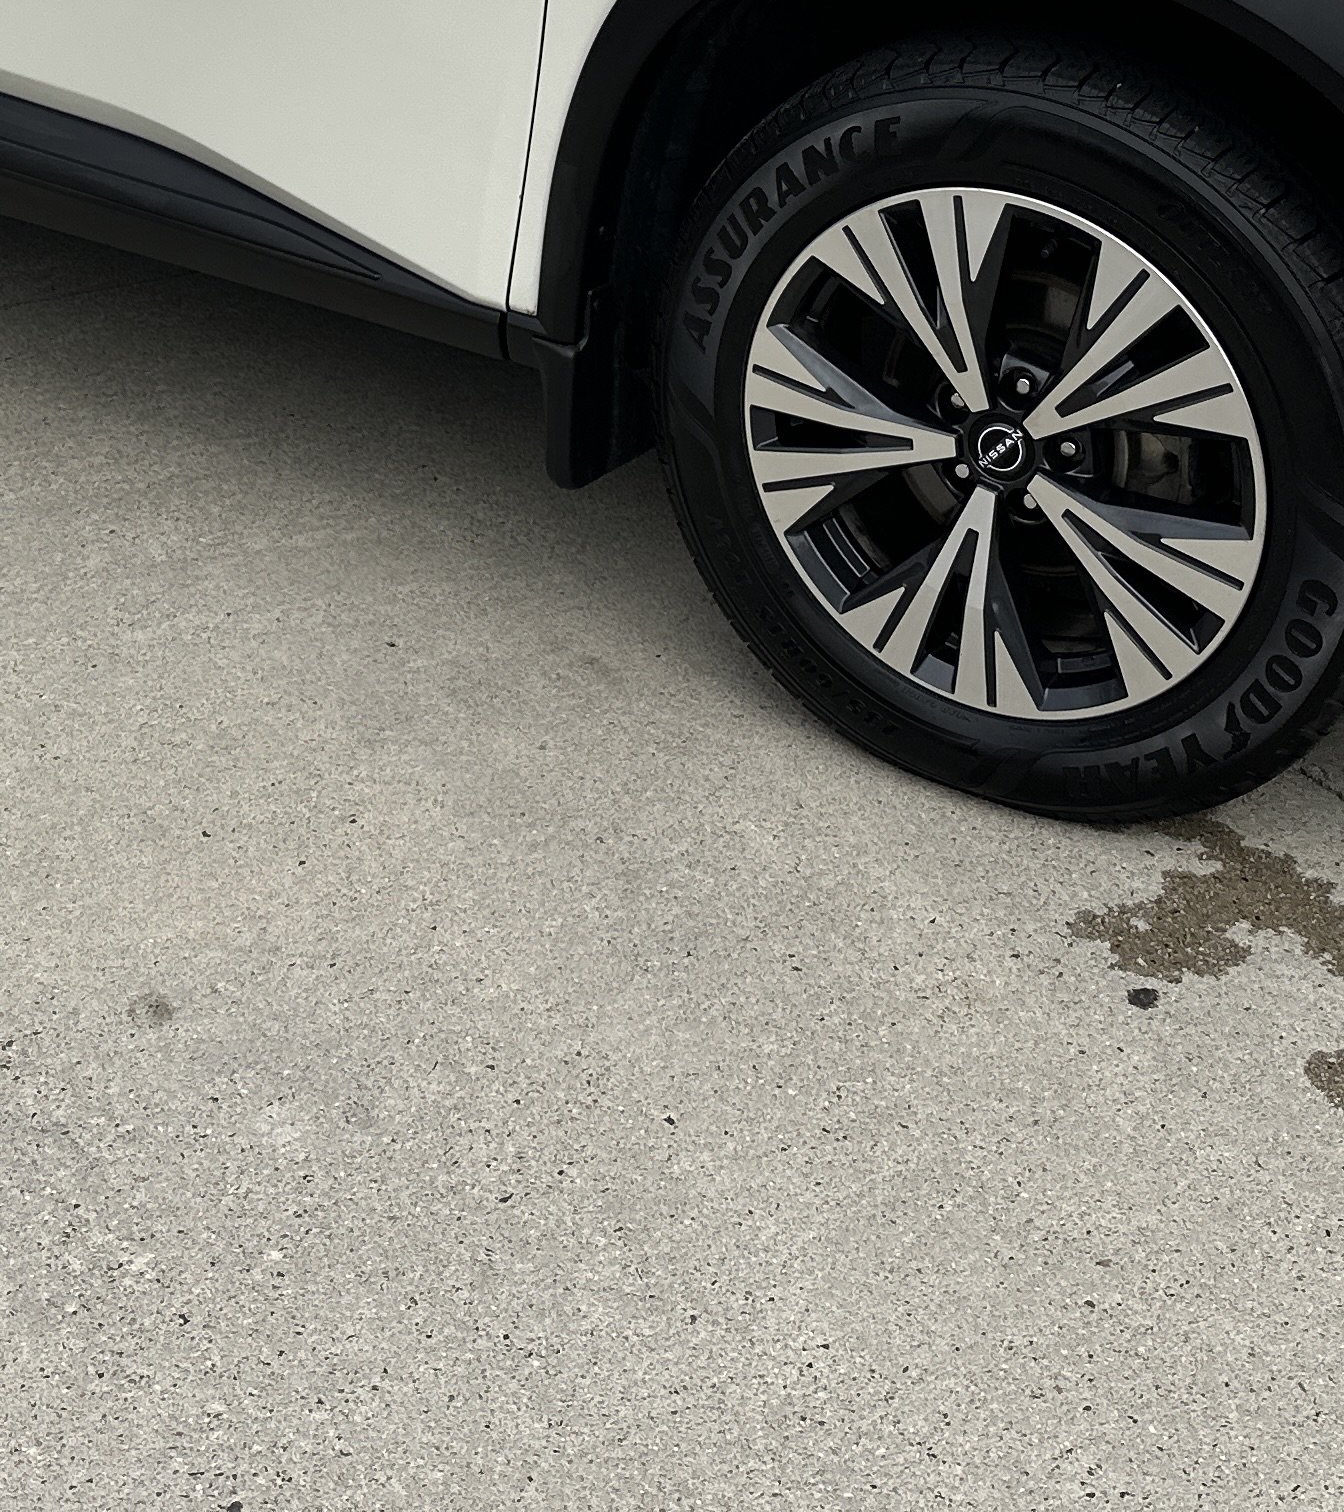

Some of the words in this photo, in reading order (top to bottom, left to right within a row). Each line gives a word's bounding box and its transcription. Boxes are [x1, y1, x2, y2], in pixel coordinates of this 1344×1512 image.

[682, 115, 901, 355] ASSURANCE
[978, 429, 1023, 468] NISSAN
[1061, 578, 1339, 806] GOODYEAR
